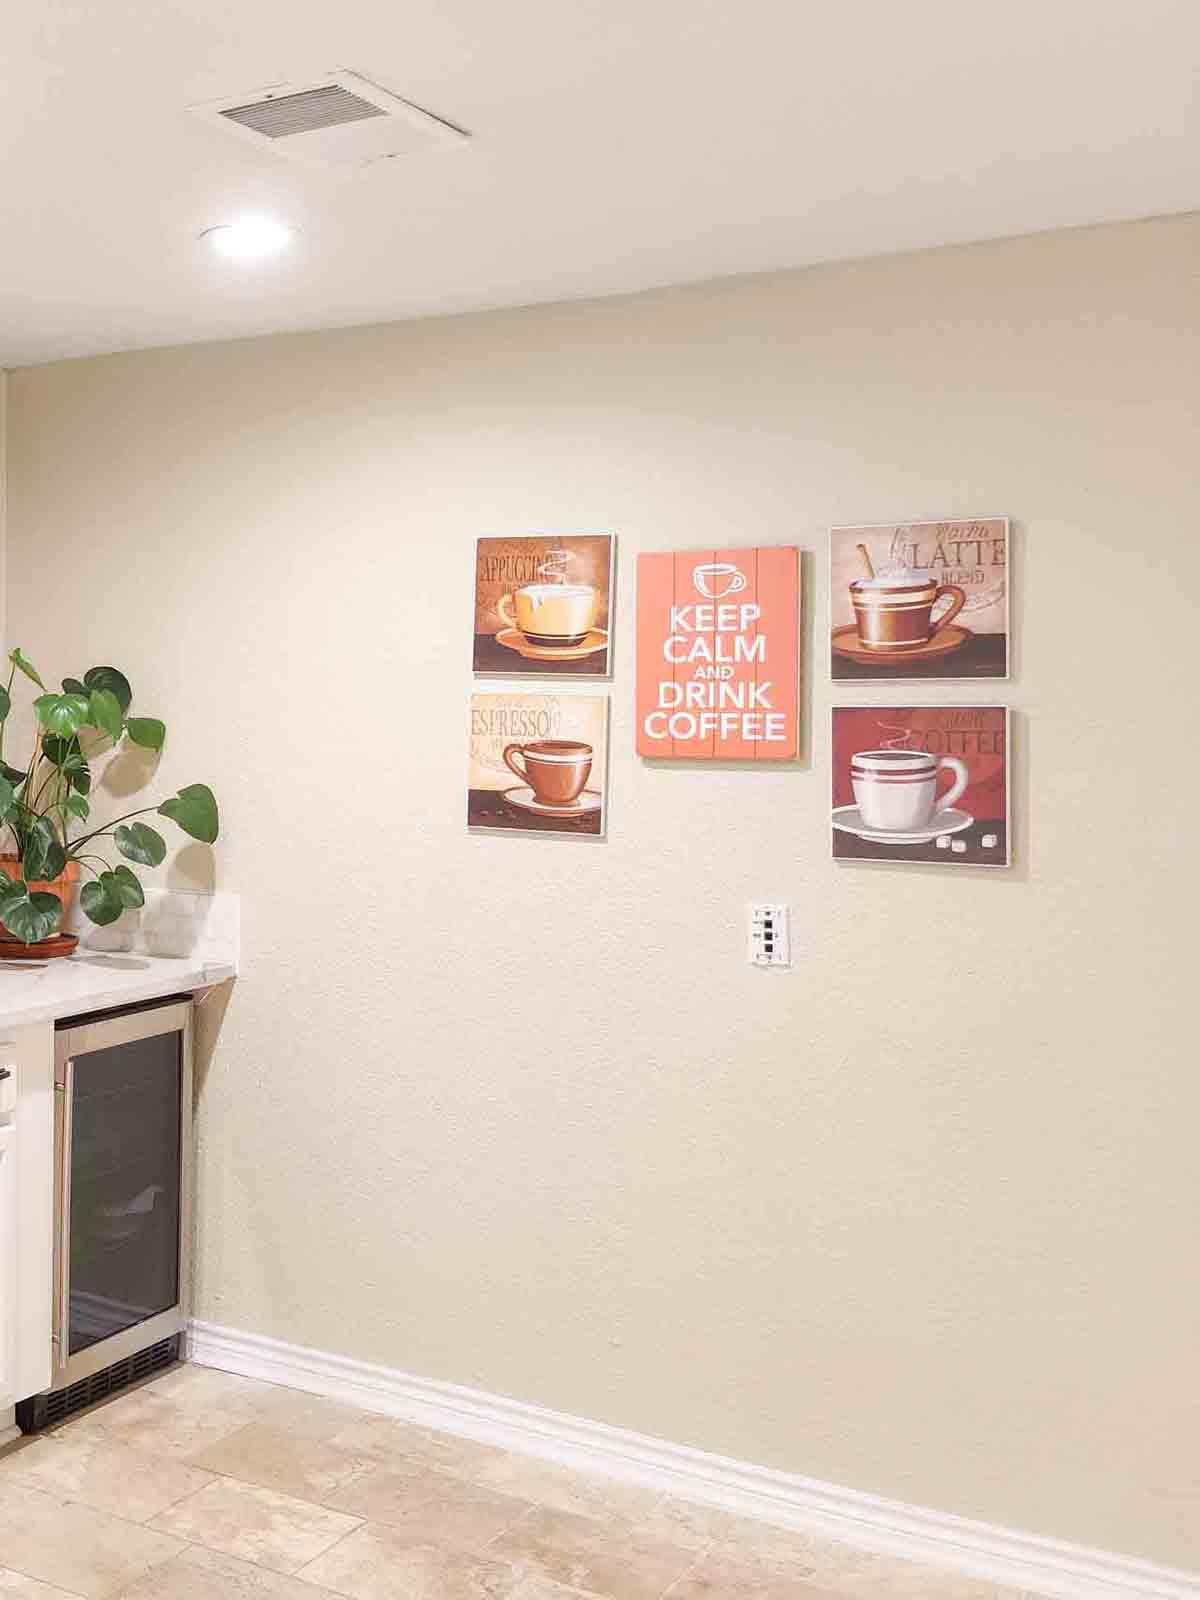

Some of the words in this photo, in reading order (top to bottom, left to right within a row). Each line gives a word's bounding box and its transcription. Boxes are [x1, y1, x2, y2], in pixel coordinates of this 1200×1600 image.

[911, 539, 1005, 570] LATTE
[668, 602, 761, 633] KEEP
[662, 633, 767, 664] CALM
[693, 664, 736, 681] AND
[656, 680, 773, 710] DRINK
[643, 710, 787, 742] COFFEE
